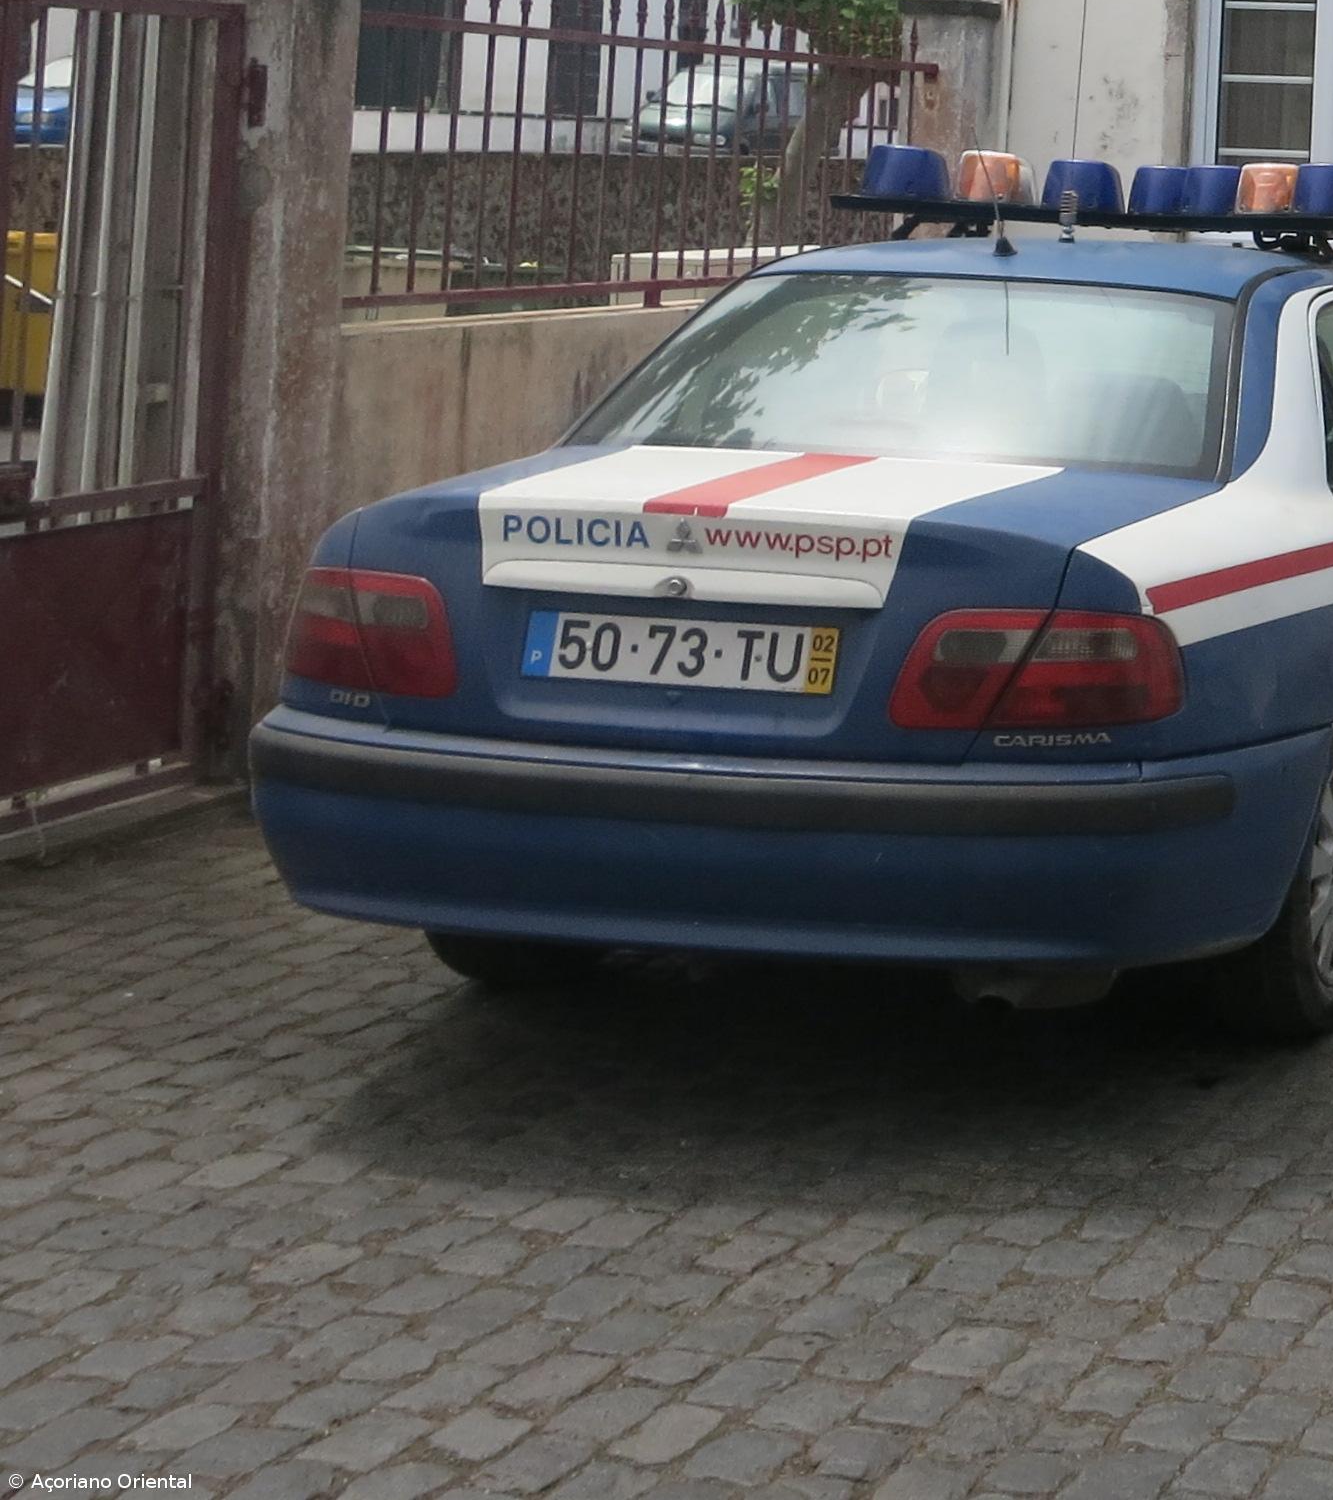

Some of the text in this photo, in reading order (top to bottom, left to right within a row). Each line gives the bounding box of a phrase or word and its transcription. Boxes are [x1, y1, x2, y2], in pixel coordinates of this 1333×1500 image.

[502, 514, 650, 549] POLICIA
[704, 526, 893, 563] www.psp.pt
[812, 634, 836, 653] 02
[530, 649, 543, 666] P
[807, 667, 831, 686] 07
[993, 732, 1112, 748] CARISMA
